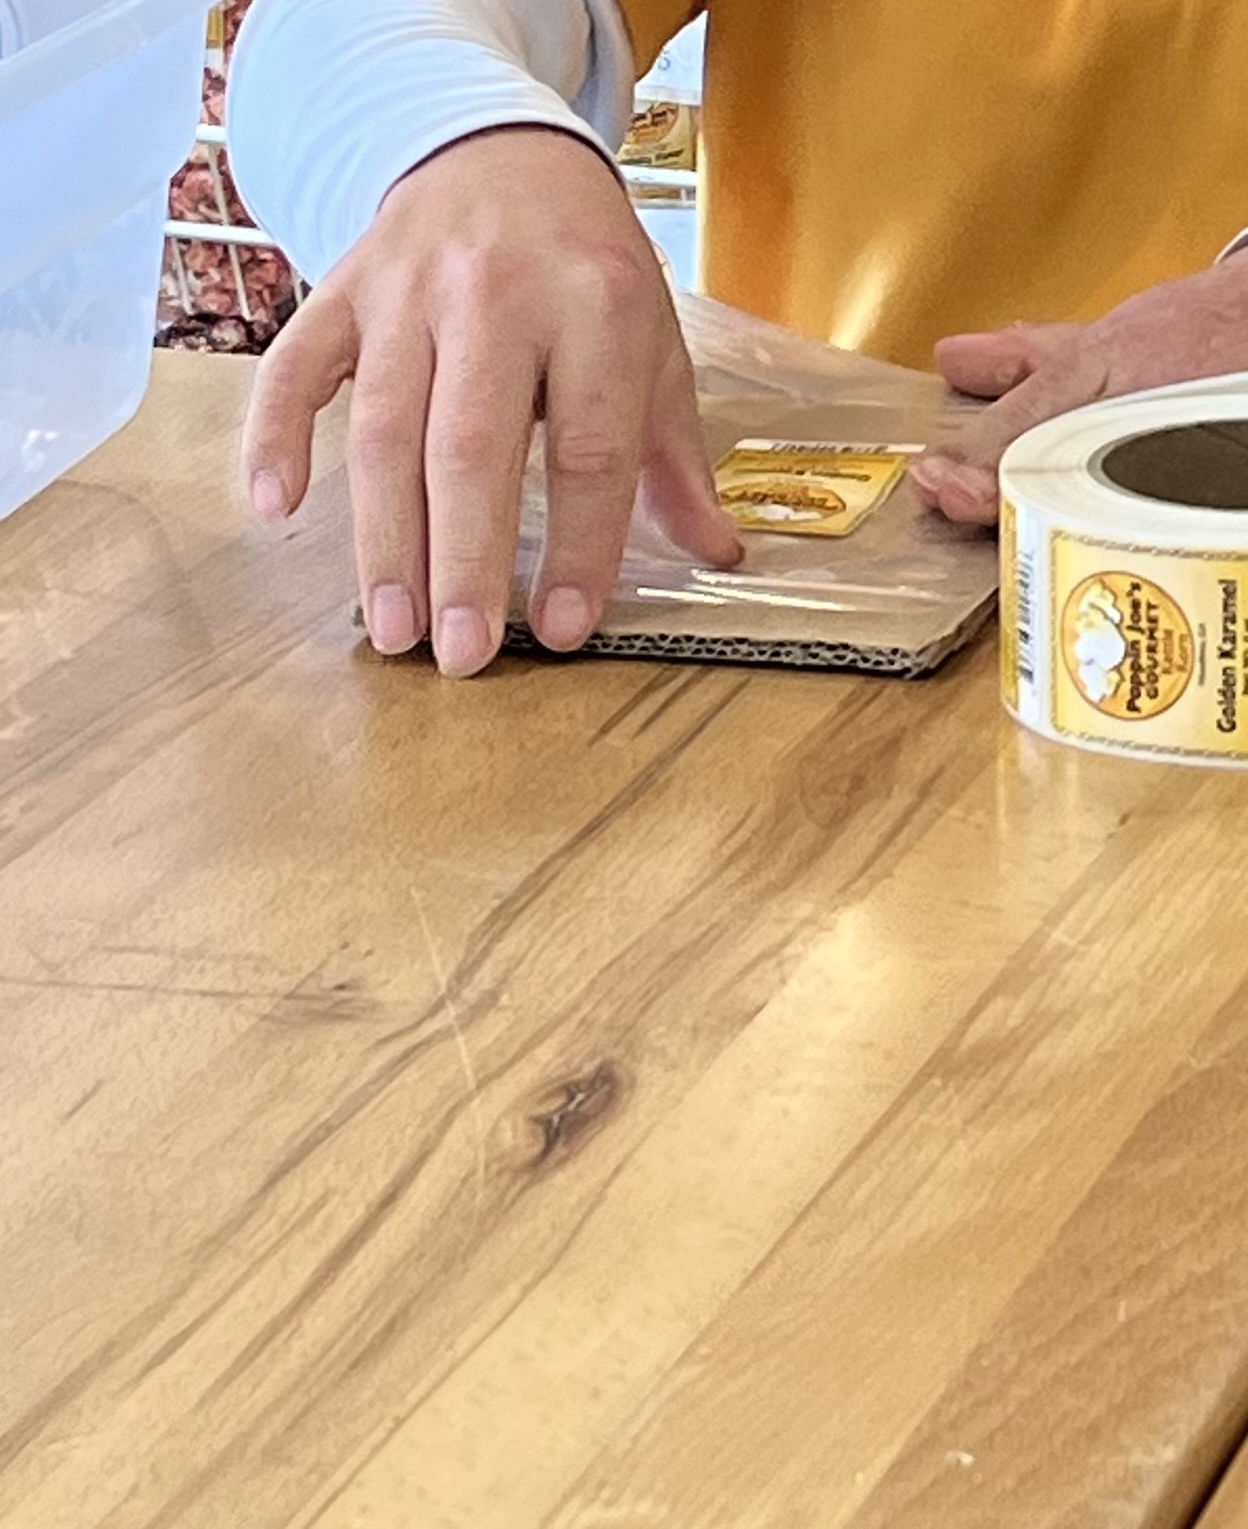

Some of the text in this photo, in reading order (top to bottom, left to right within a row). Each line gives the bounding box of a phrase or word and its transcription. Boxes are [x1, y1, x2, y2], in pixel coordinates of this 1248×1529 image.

[1125, 581, 1146, 713] Poppin Joe's
[1146, 598, 1159, 700] GOURMET
[1216, 579, 1238, 733] Golden Karamel
